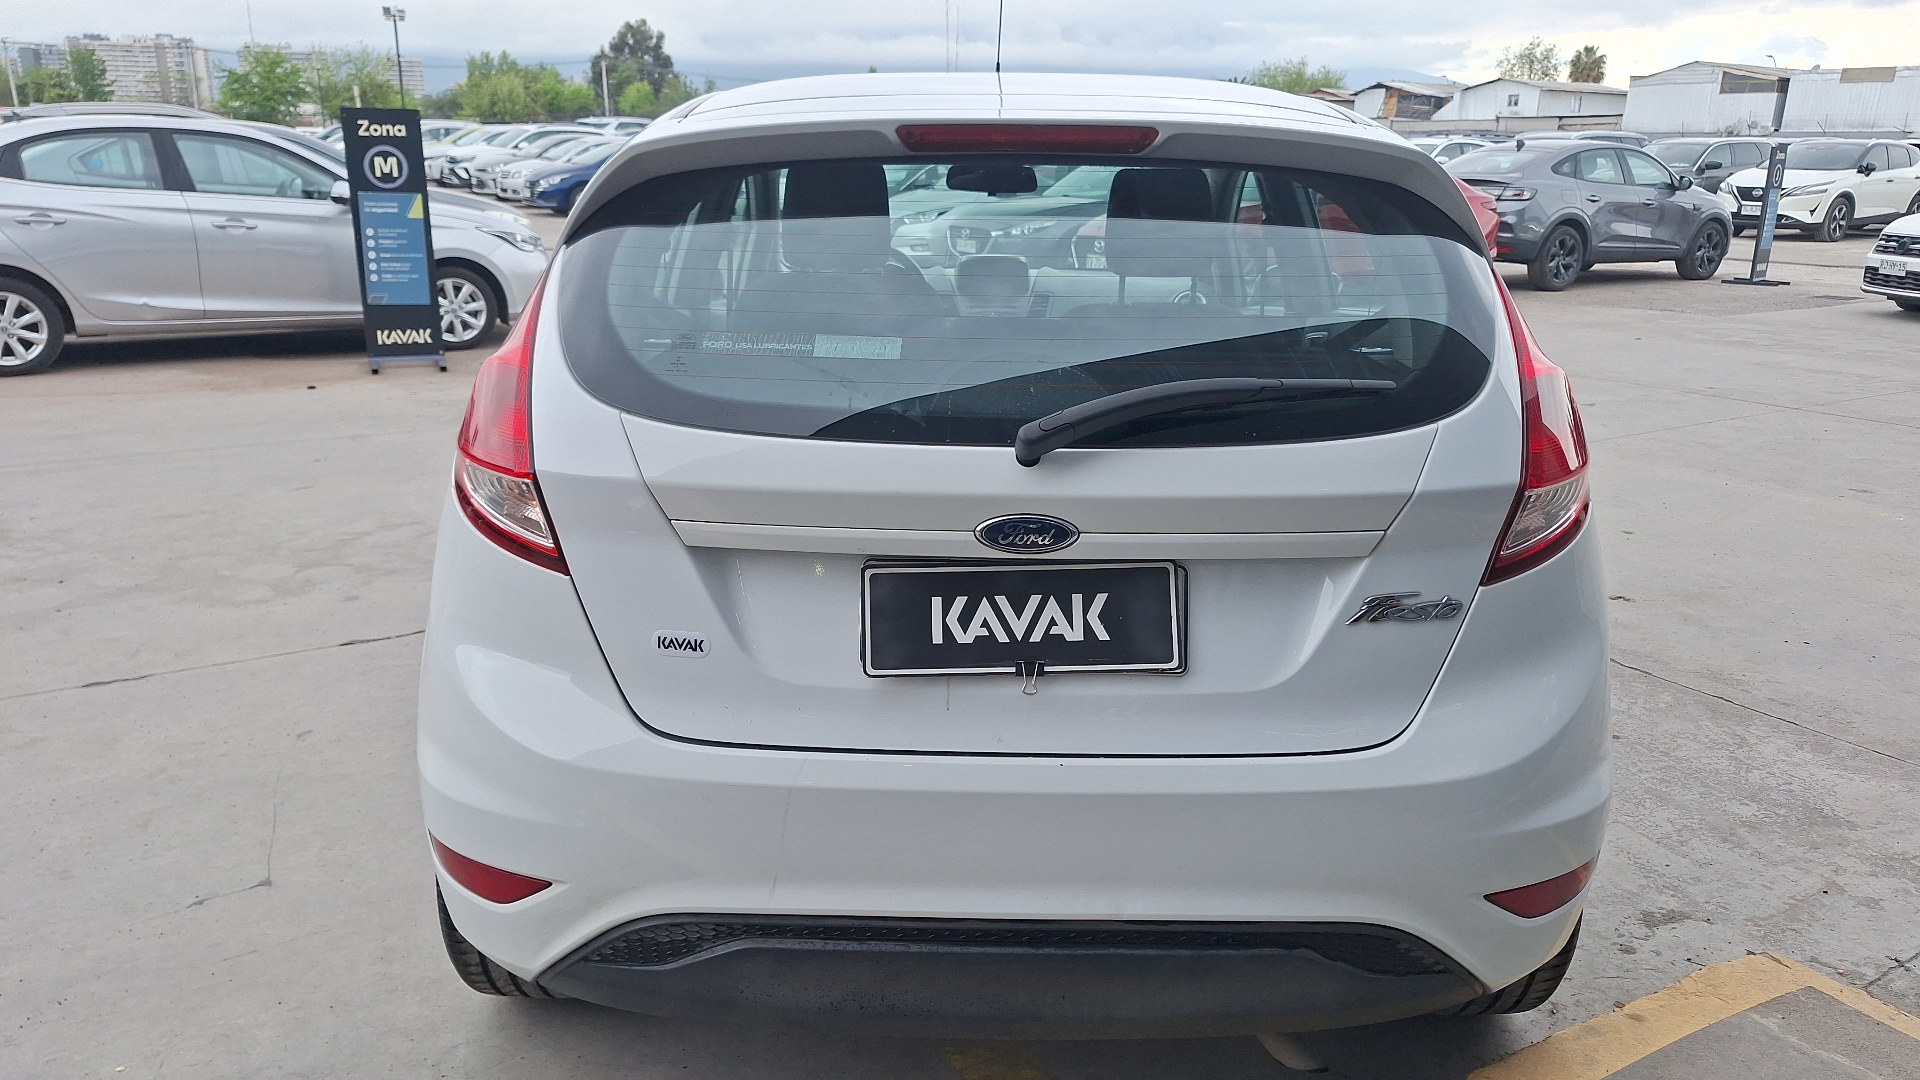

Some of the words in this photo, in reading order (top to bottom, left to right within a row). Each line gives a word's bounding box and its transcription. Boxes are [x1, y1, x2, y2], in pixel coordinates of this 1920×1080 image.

[356, 119, 407, 137] Zona
[373, 156, 399, 178] M
[376, 328, 433, 345] KAVAK
[702, 341, 732, 349] FORD
[997, 522, 1056, 545] Ford
[1344, 591, 1464, 625] Fiesta
[931, 593, 1111, 644] KAVAK
[657, 635, 705, 653] KAVAK
